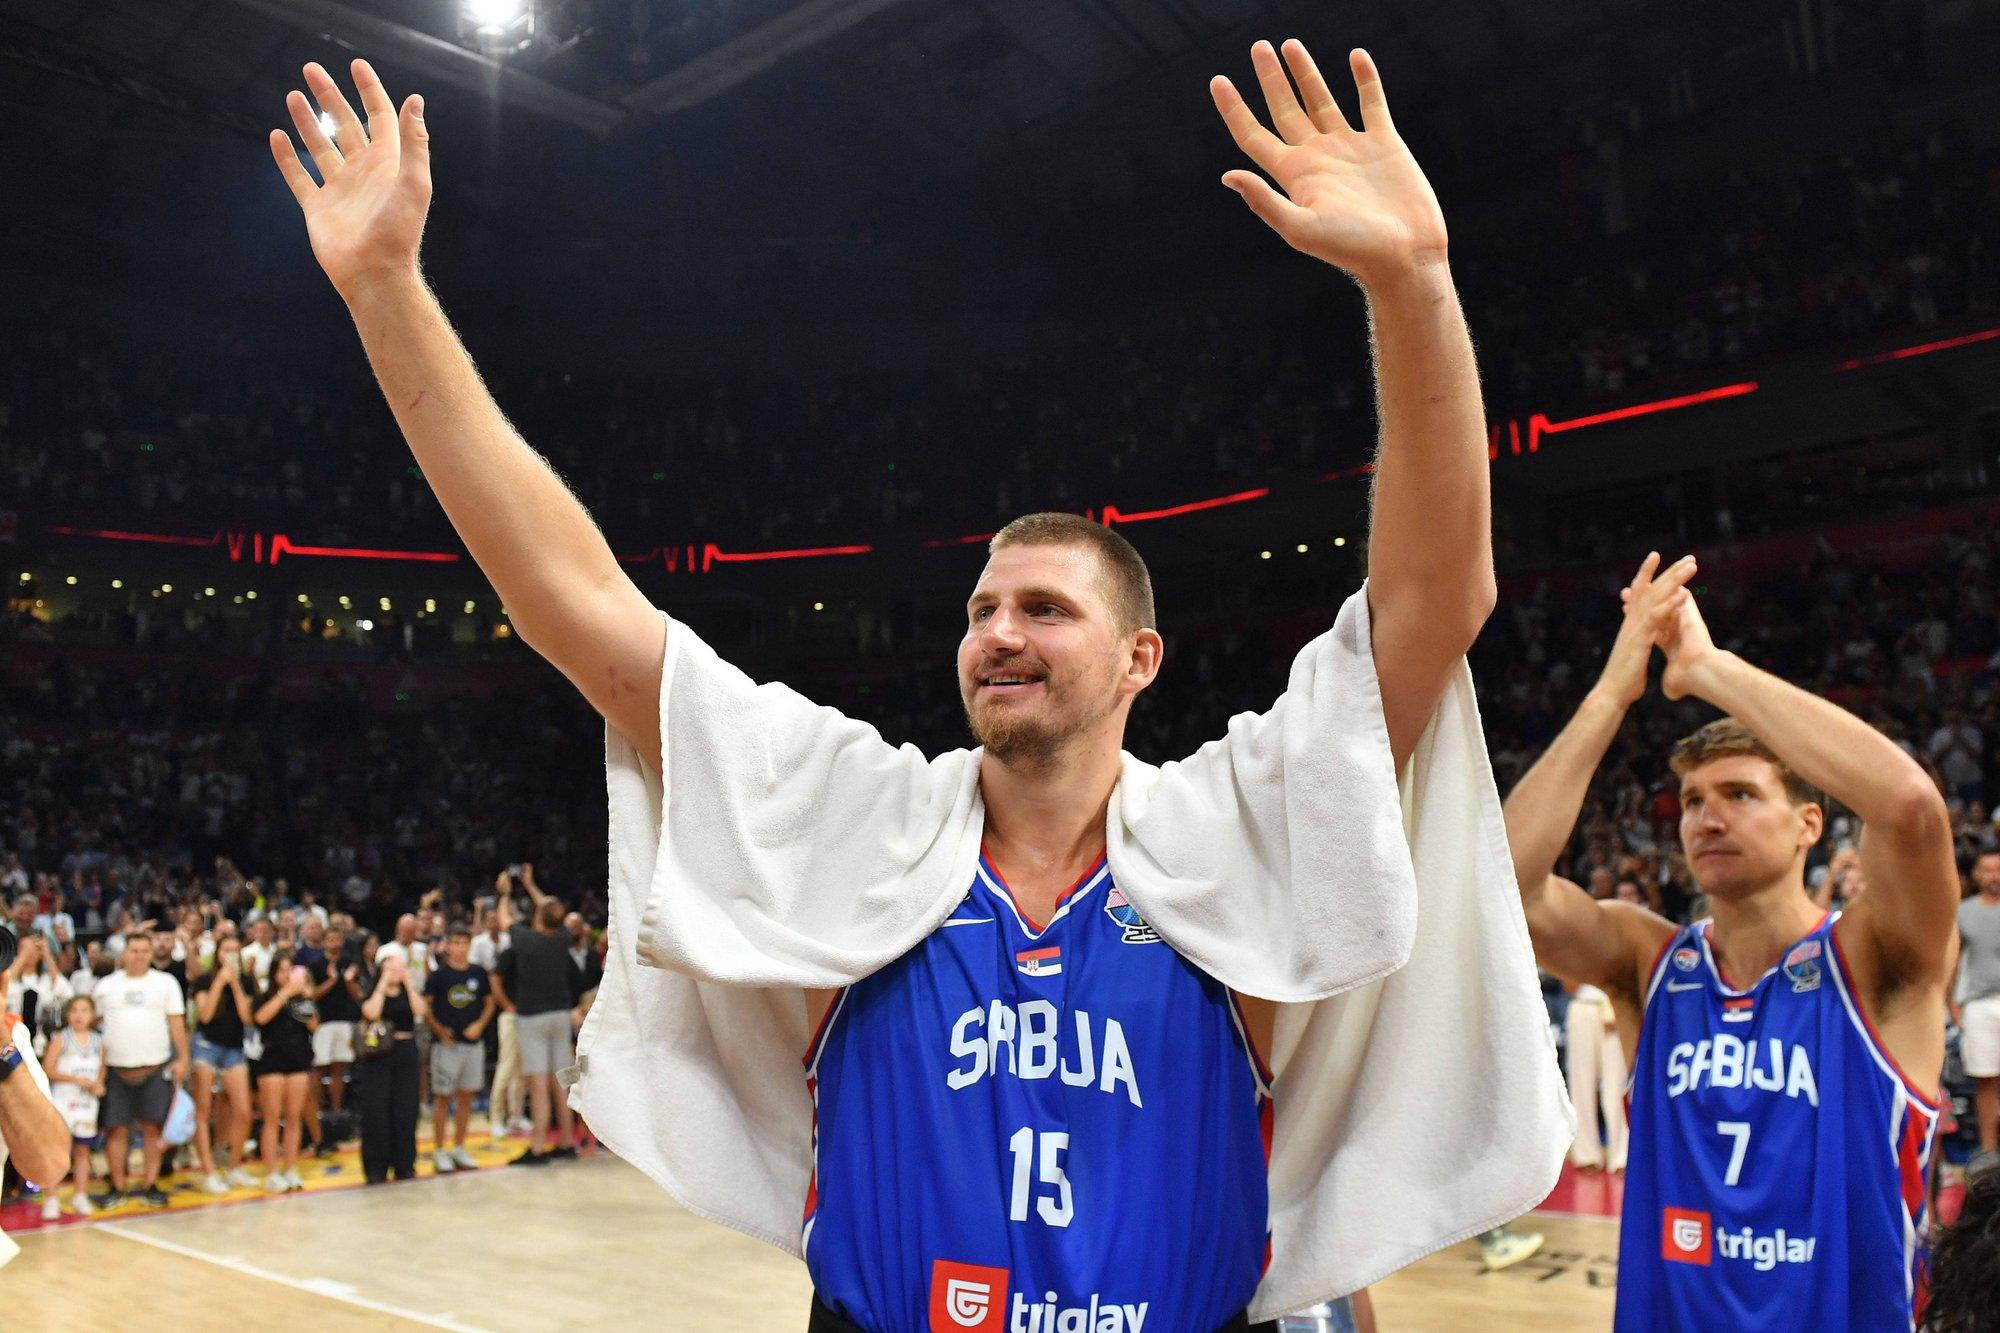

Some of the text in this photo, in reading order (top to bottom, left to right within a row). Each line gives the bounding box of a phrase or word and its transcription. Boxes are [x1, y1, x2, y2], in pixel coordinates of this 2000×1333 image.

[946, 999, 1143, 1109] SRBJA
[1008, 1126, 1074, 1228] 15
[1716, 1121, 1751, 1187] 7
